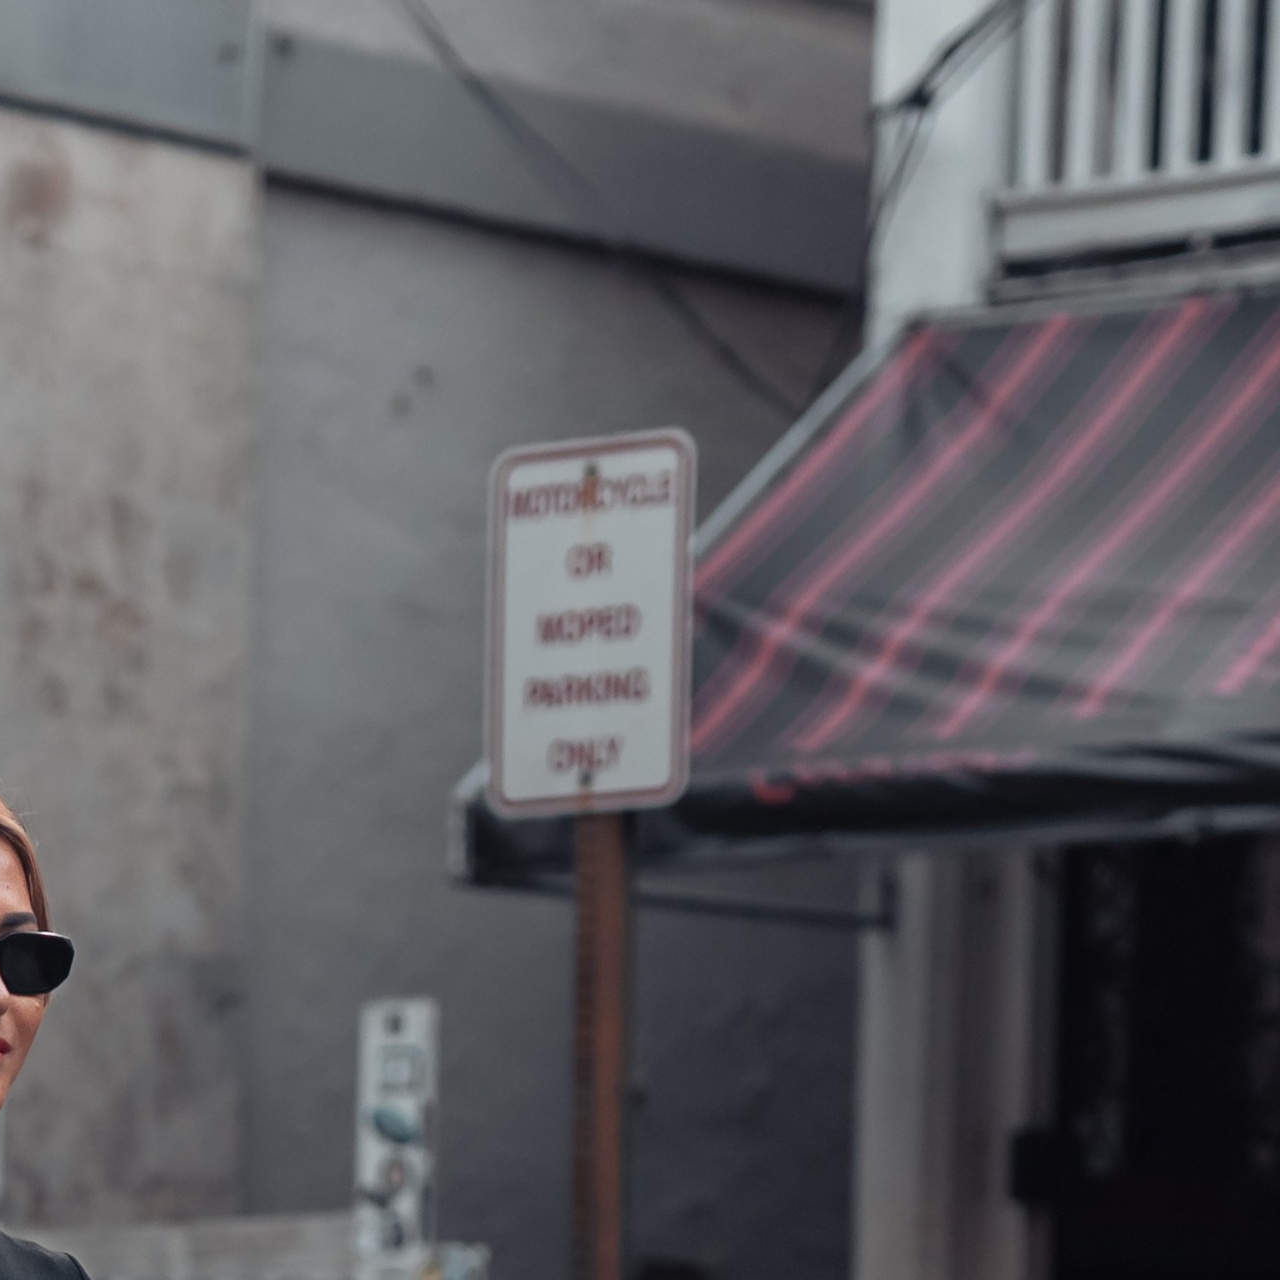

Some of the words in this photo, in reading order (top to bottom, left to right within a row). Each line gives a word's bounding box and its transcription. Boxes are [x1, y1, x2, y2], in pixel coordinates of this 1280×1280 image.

[567, 543, 611, 577] OR
[534, 603, 642, 644] MOPED
[524, 667, 650, 706] PARKING
[547, 735, 624, 774] ONLY
